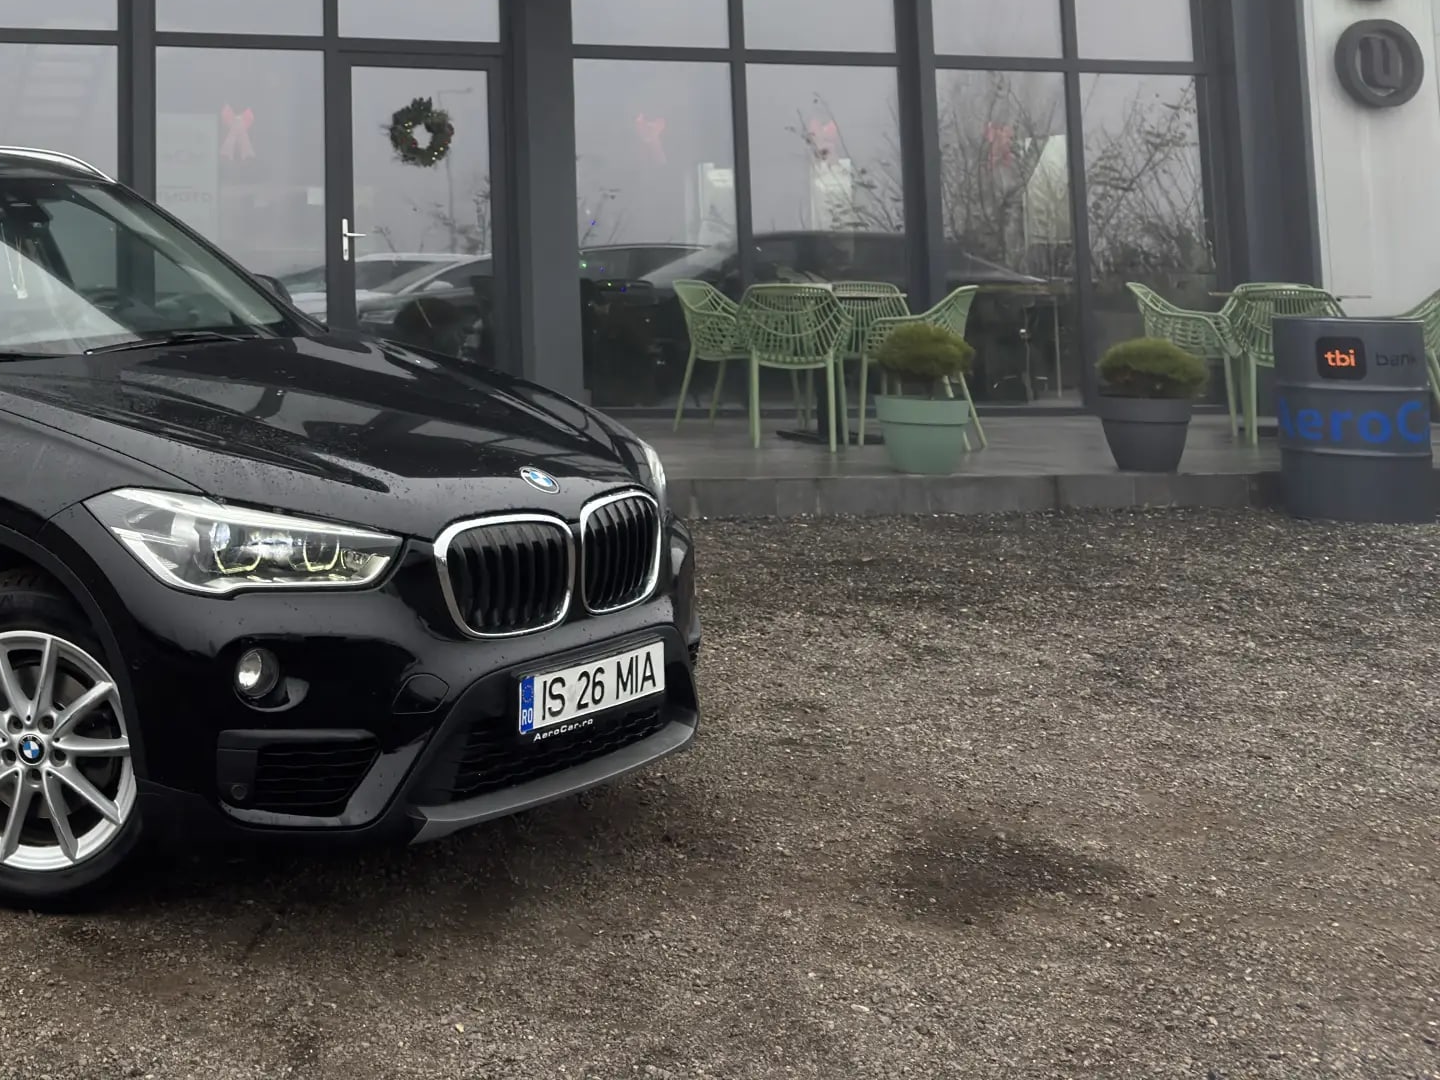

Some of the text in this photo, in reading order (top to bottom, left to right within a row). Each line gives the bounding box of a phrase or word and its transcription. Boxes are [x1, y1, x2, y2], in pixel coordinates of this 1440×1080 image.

[1324, 349, 1356, 367] tbi
[1279, 396, 1430, 444] eroC
[541, 650, 657, 721] IS 26 MIA
[522, 708, 533, 725] RO
[533, 718, 594, 742] AeroCar.ro
